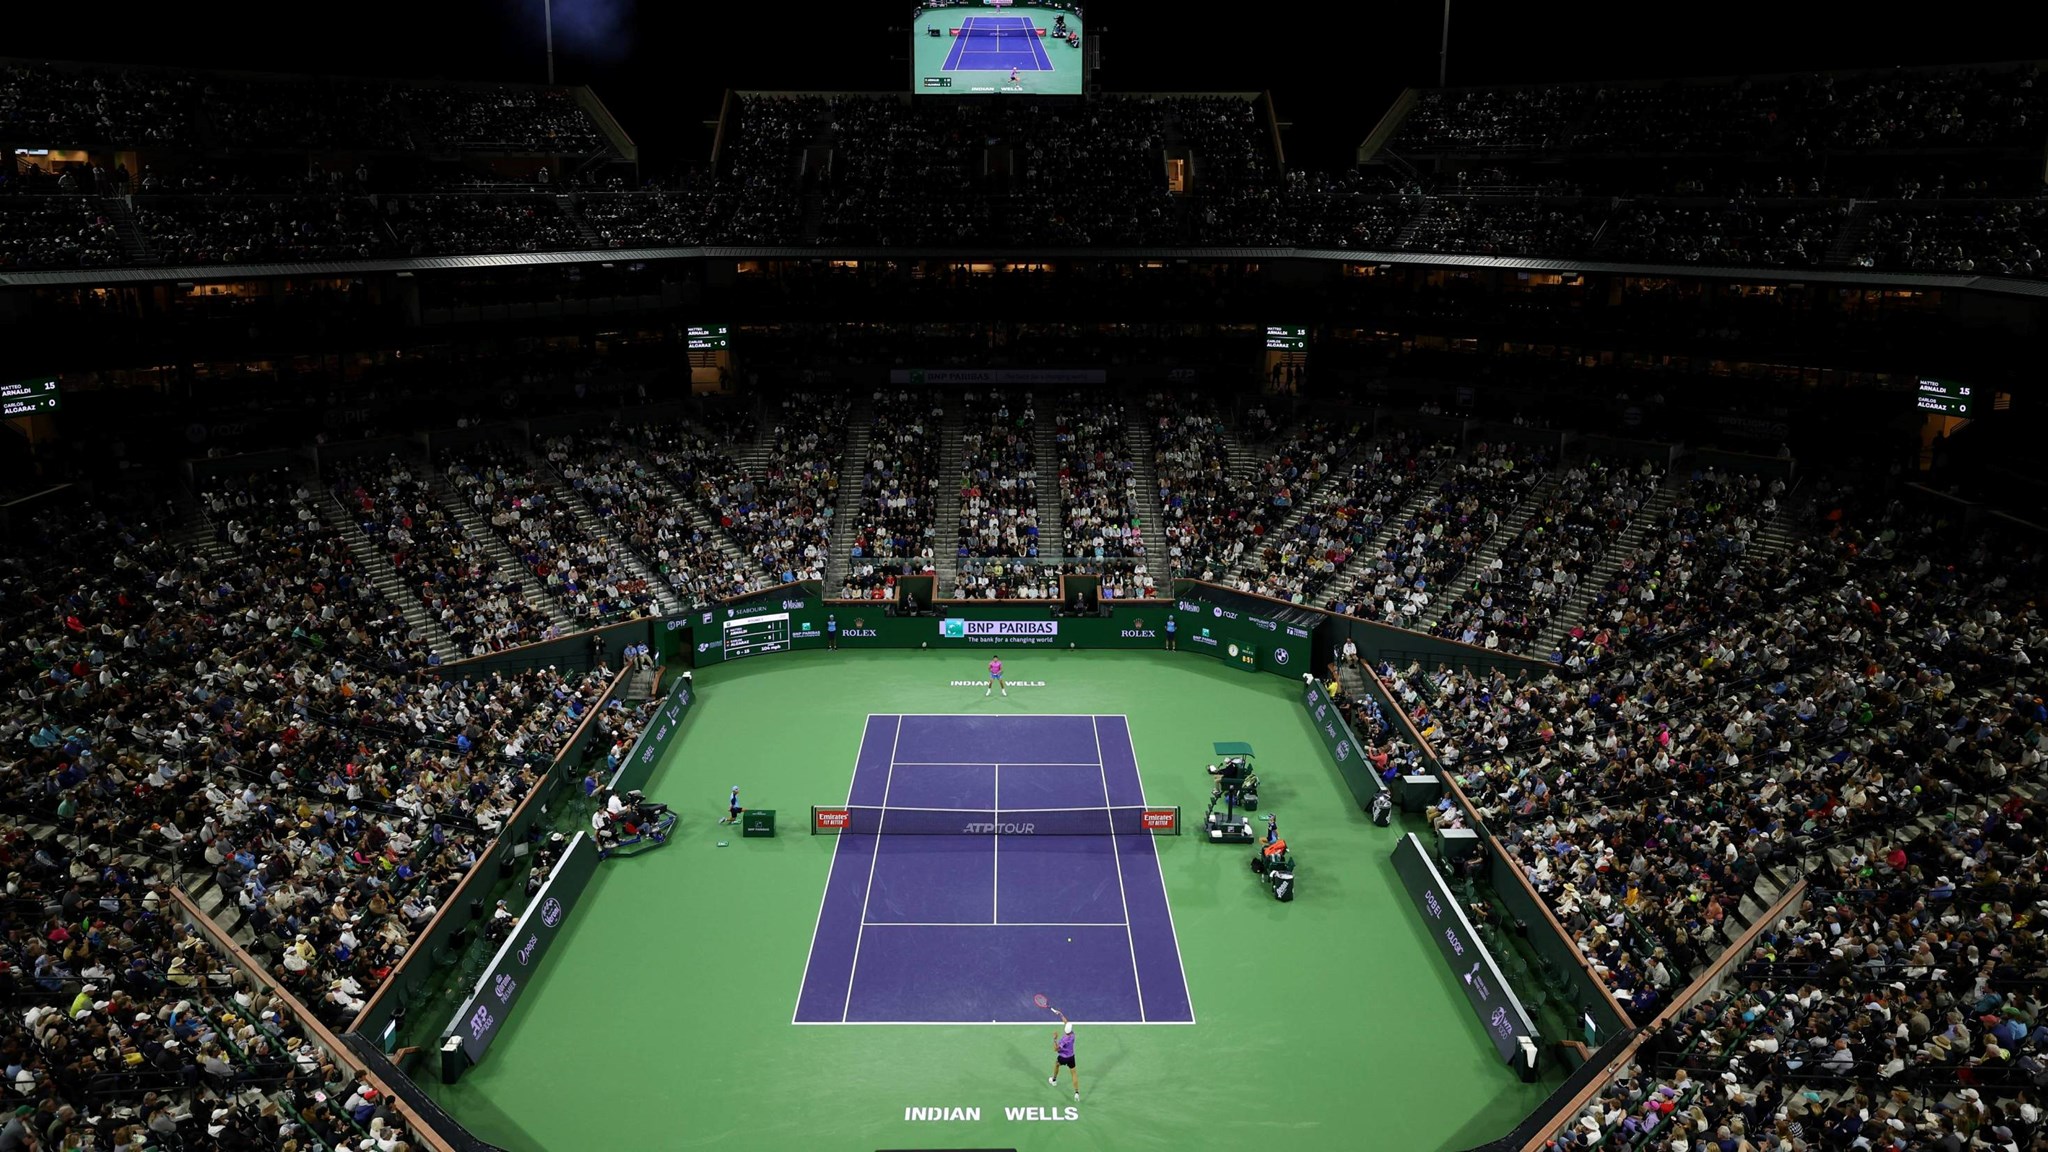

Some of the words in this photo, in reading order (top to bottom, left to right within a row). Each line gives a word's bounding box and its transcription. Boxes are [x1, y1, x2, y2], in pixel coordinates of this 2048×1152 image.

[44, 381, 55, 390] 15
[1919, 385, 1946, 393] ARNALDI
[2, 388, 31, 397] ARNALDI
[1959, 387, 1970, 395] 15
[48, 399, 56, 407] 0
[1917, 402, 1947, 411] ALCARAZ
[1959, 404, 1966, 412] 0
[4, 405, 36, 414] ALCARAZ
[736, 606, 767, 615] SEABOURN
[1222, 611, 1238, 619] razr
[675, 619, 687, 628] PIF
[968, 623, 994, 633] BNP
[1000, 623, 1053, 633] PARIBAS
[963, 823, 996, 833] ATP
[997, 824, 1034, 833] TOUR
[1425, 890, 1442, 919] DOBEL
[545, 906, 560, 925] Veroni
[524, 933, 538, 957] pepsi
[1445, 926, 1464, 956] HOLOGIC
[500, 980, 516, 1004] PREMIER
[470, 1005, 488, 1037] ATP
[484, 1014, 494, 1031] 1000
[1503, 1017, 1513, 1035] WTA
[1498, 1024, 1508, 1040] 1000
[904, 1107, 981, 1121] INDIAN
[1005, 1107, 1079, 1121] WELLS
